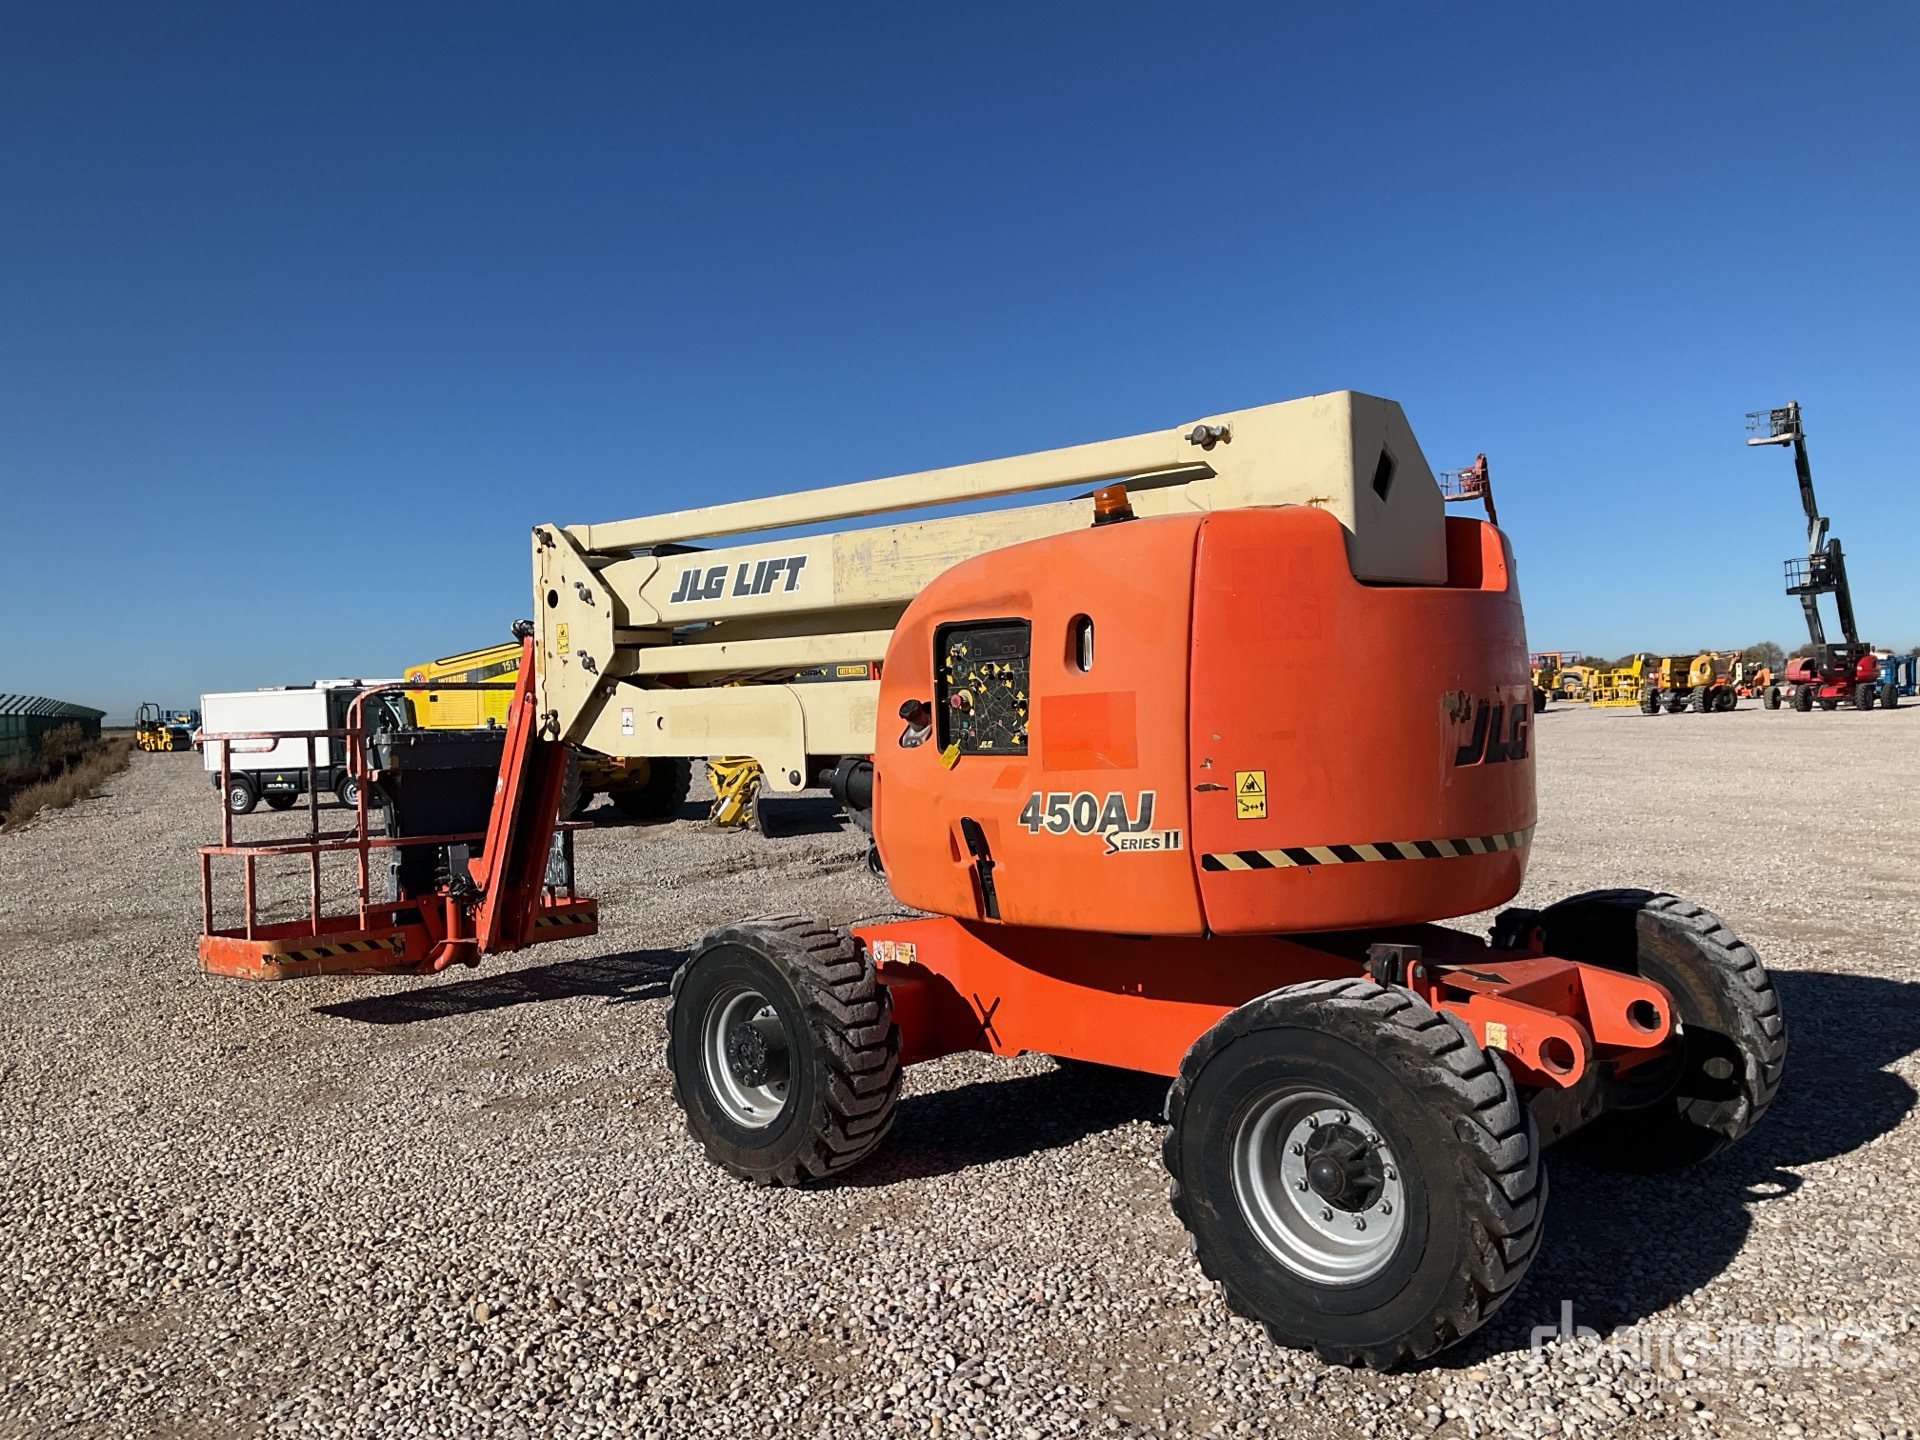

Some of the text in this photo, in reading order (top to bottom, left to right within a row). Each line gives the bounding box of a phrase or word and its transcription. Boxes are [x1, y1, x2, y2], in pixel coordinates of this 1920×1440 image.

[669, 554, 808, 604] JLG LIFT
[1453, 703, 1529, 767] JLG
[1019, 791, 1155, 834] 450AJ
[1105, 830, 1181, 855] SERIES II
